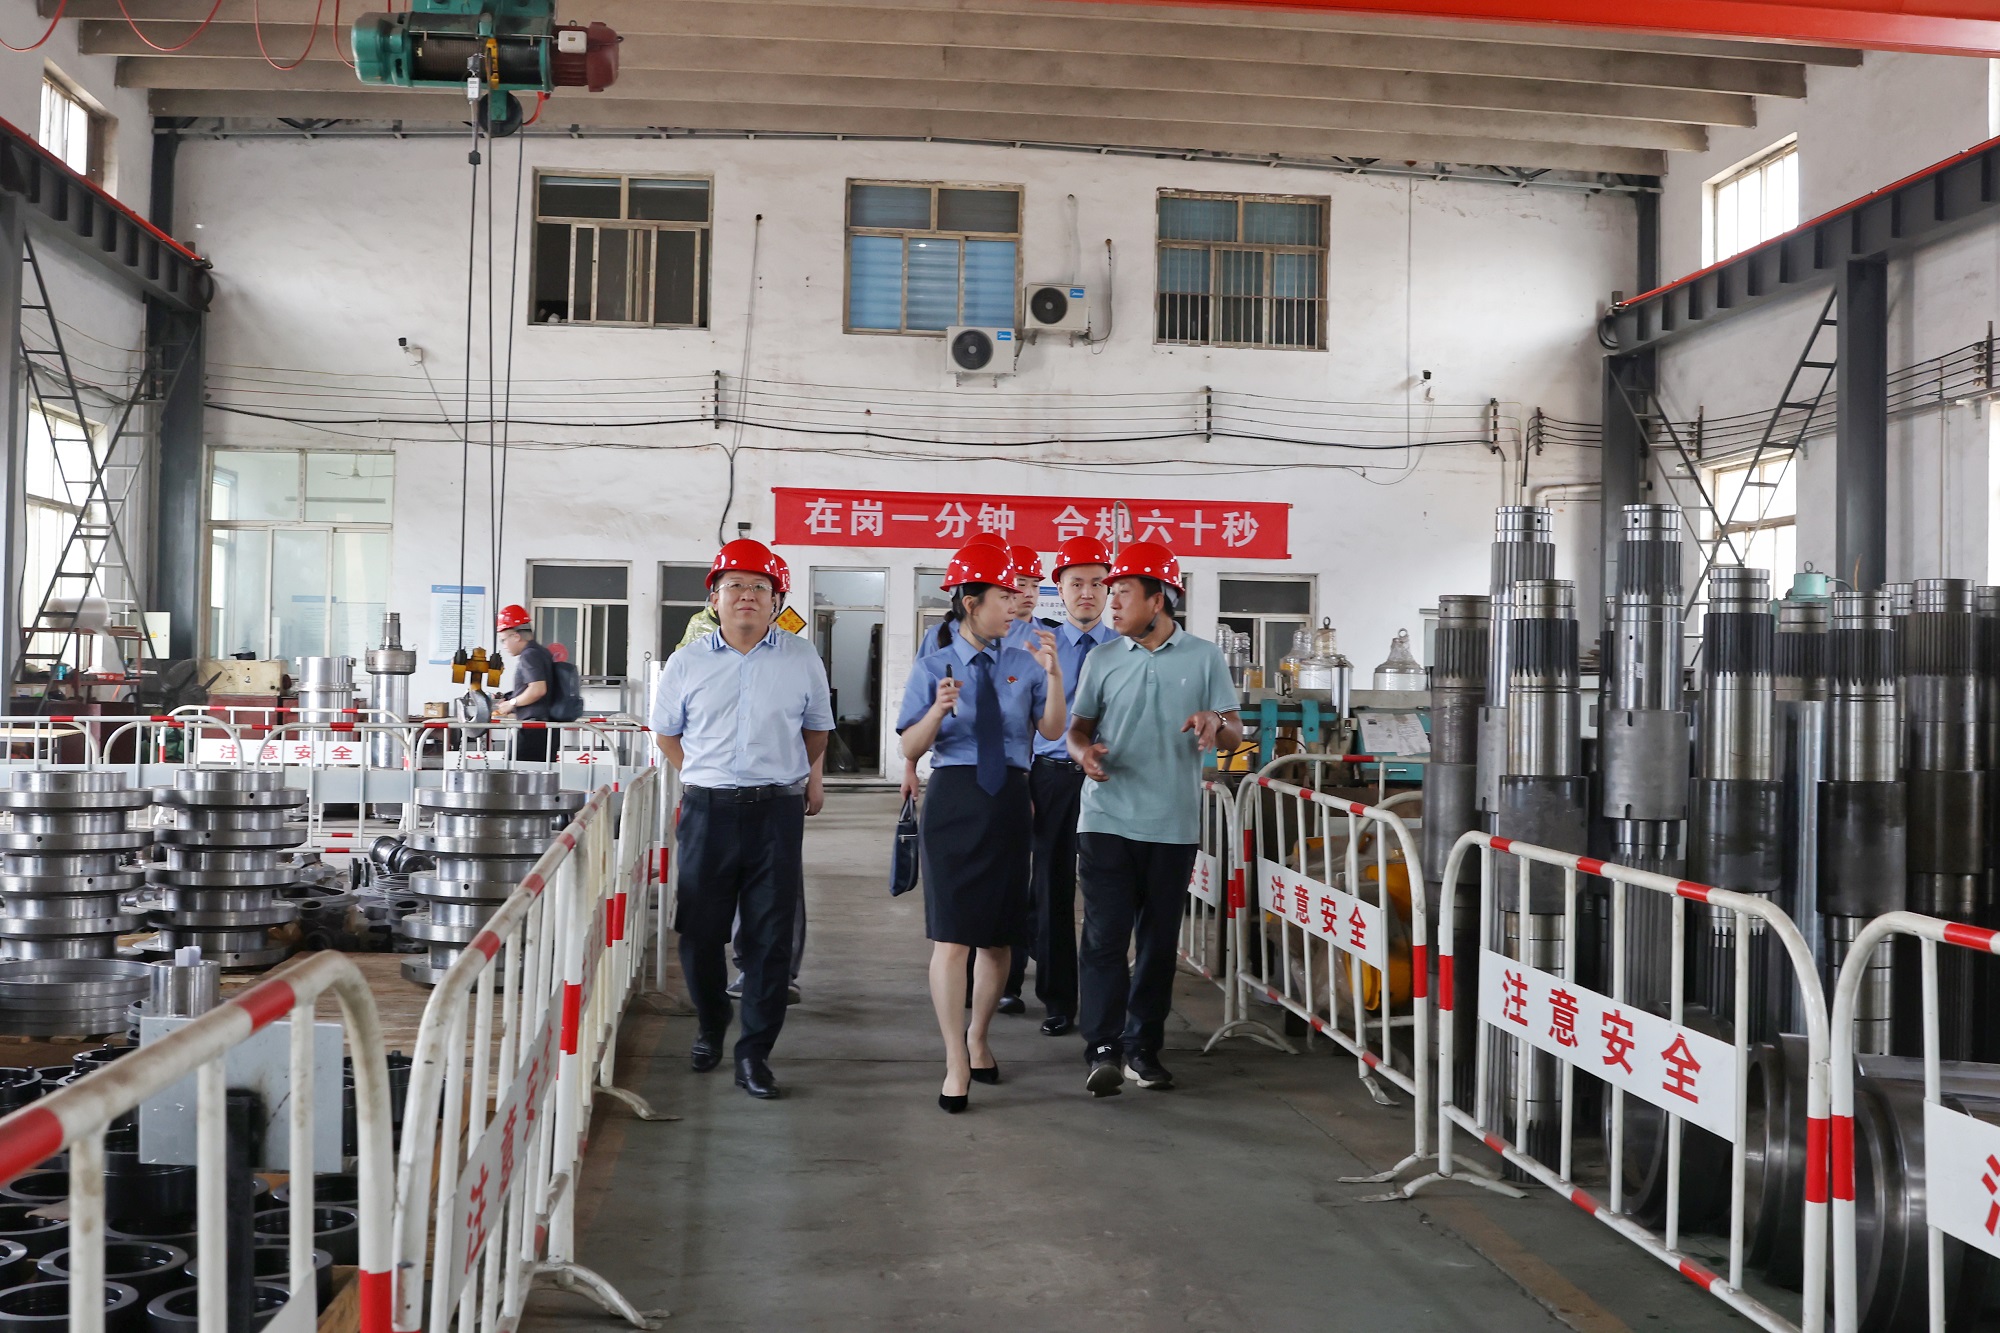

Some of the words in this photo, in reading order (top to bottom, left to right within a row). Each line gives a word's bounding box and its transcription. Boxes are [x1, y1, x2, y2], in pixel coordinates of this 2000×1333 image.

[804, 498, 1015, 540] 在岗一分钟
[1052, 504, 1260, 548] 合规六十秒
[219, 744, 353, 760] 注意安全
[1271, 875, 1367, 950] 注意安全
[1502, 969, 1702, 1105] 注意安全
